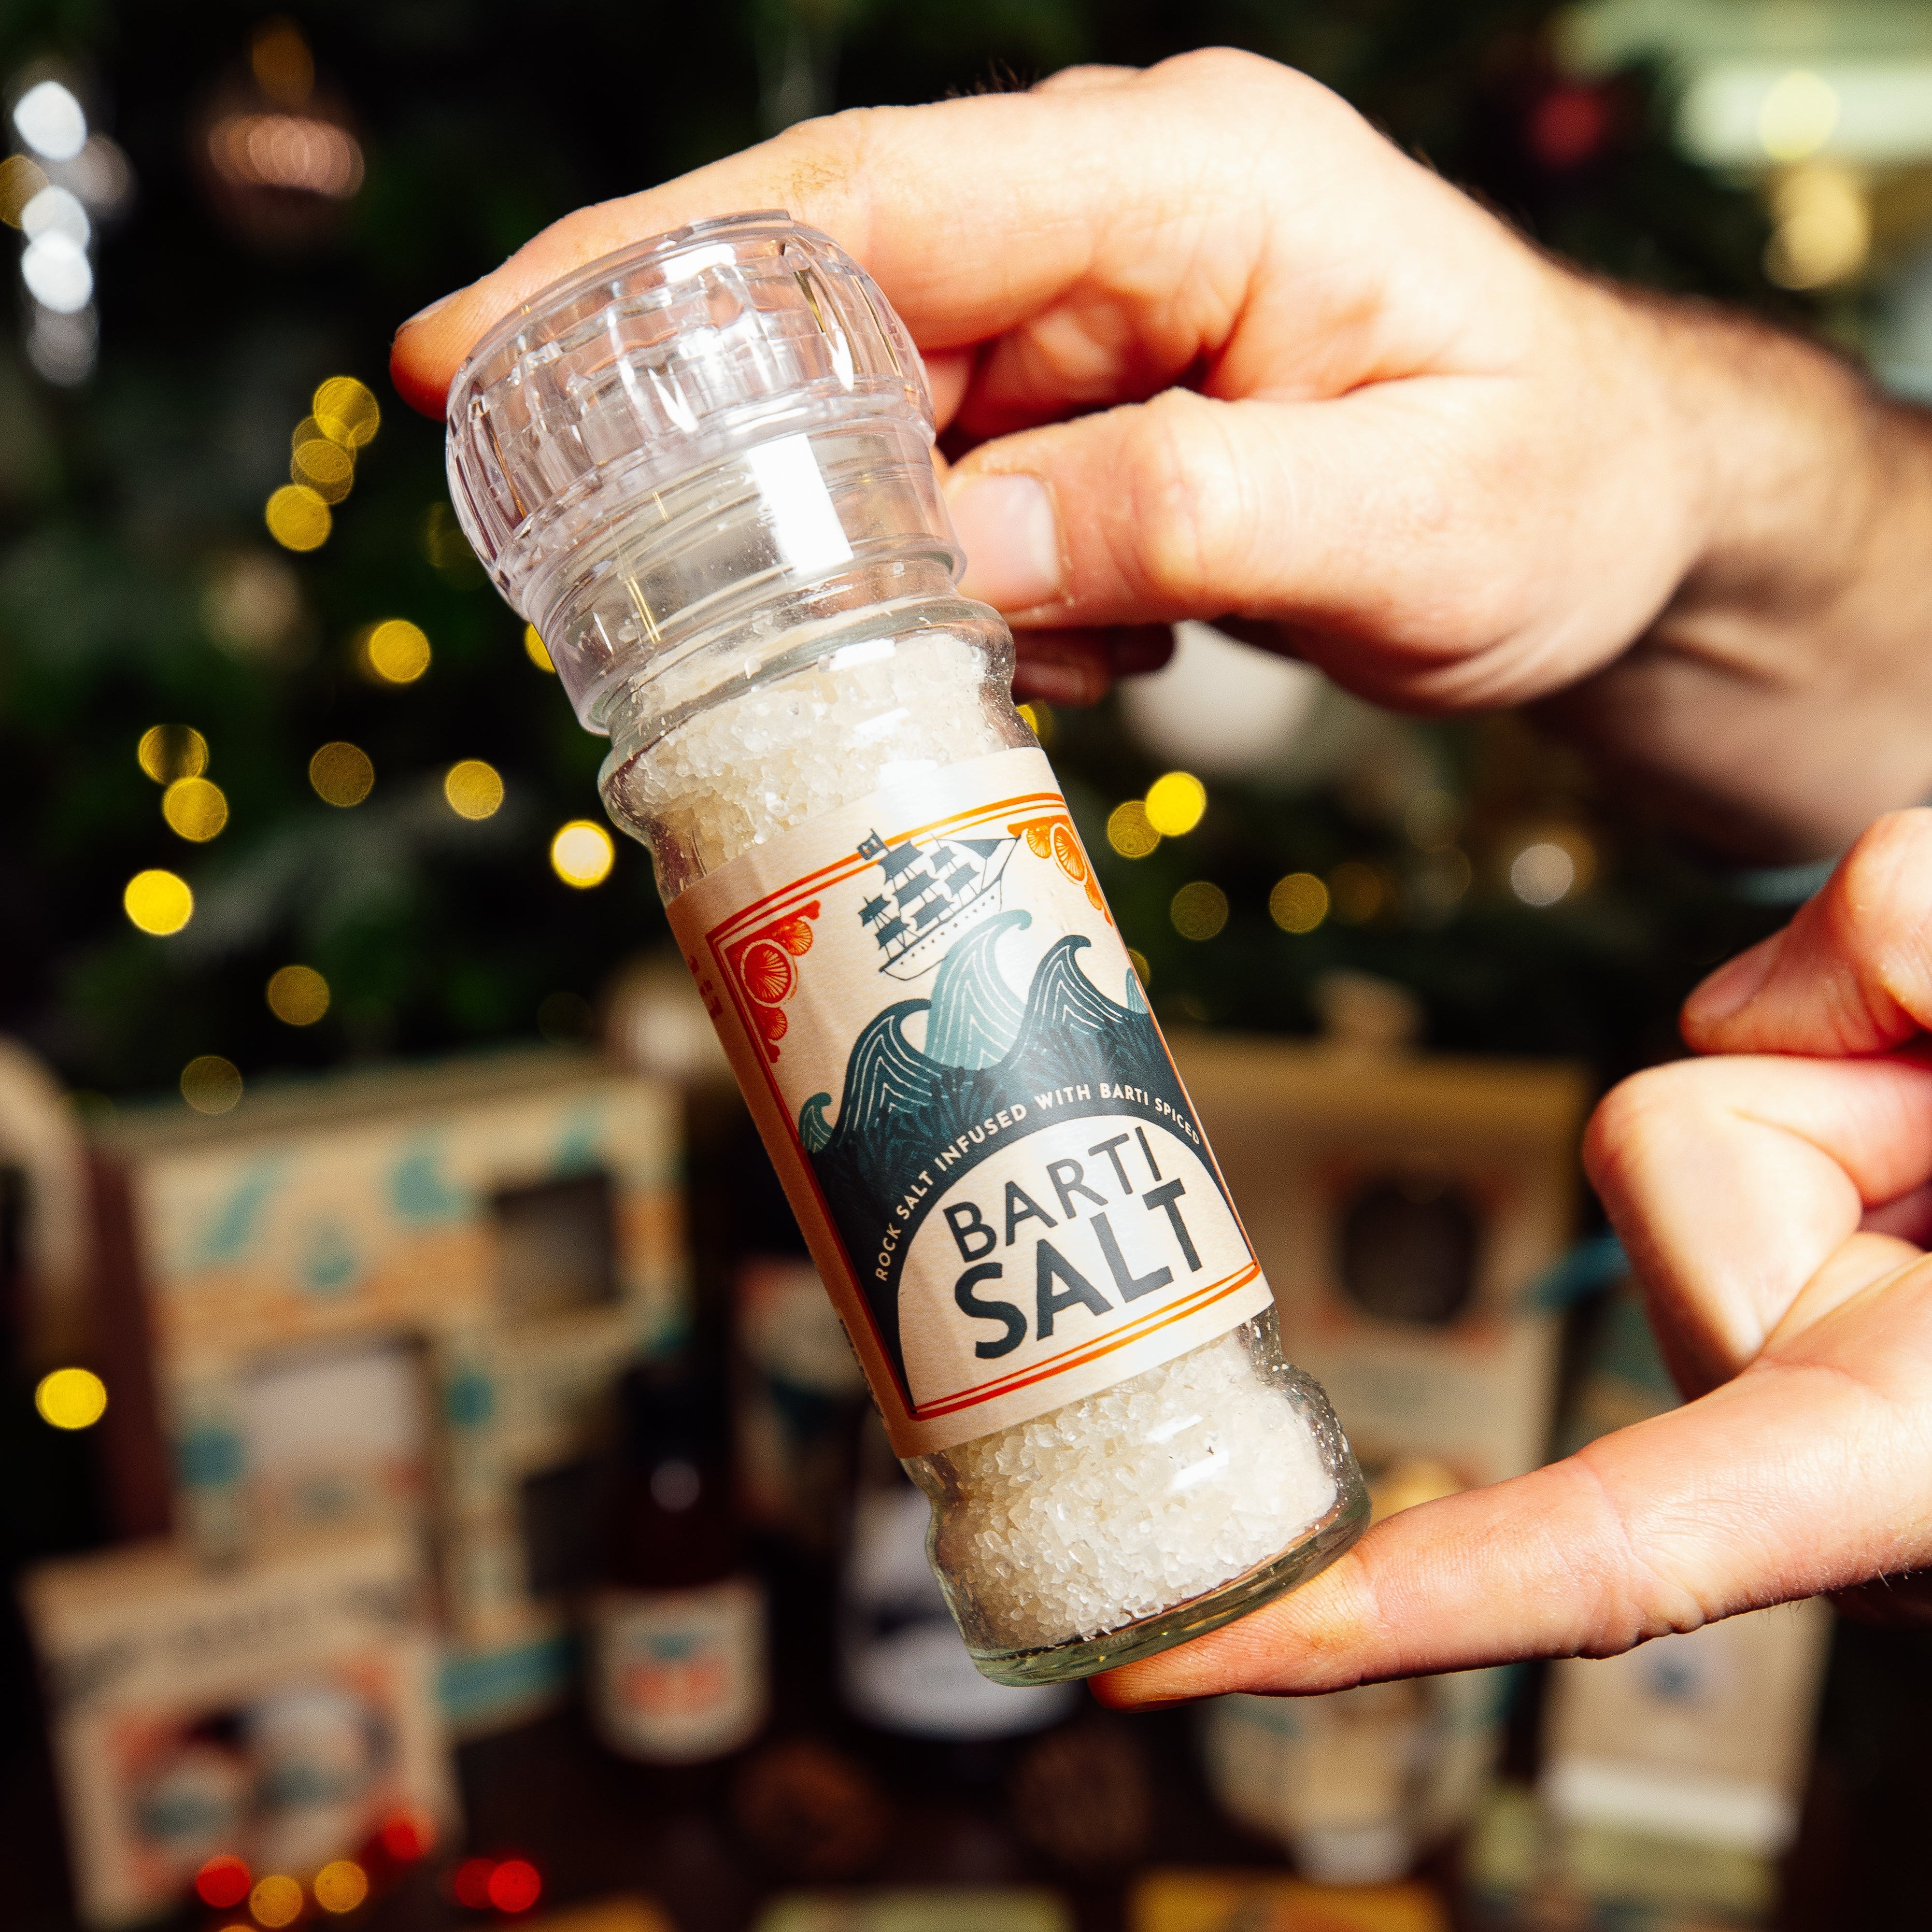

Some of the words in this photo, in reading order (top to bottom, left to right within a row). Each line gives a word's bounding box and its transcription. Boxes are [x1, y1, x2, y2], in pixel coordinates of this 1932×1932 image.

[875, 1223, 902, 1281] ROCK
[896, 1170, 934, 1220] SALT
[934, 1104, 1027, 1172] INFUSED
[1035, 1084, 1091, 1110] WITH
[1100, 1083, 1149, 1105] BARTI
[1155, 1097, 1200, 1145] SPICED
[943, 1126, 1162, 1263] BARTI
[954, 1178, 1203, 1359] SALT
